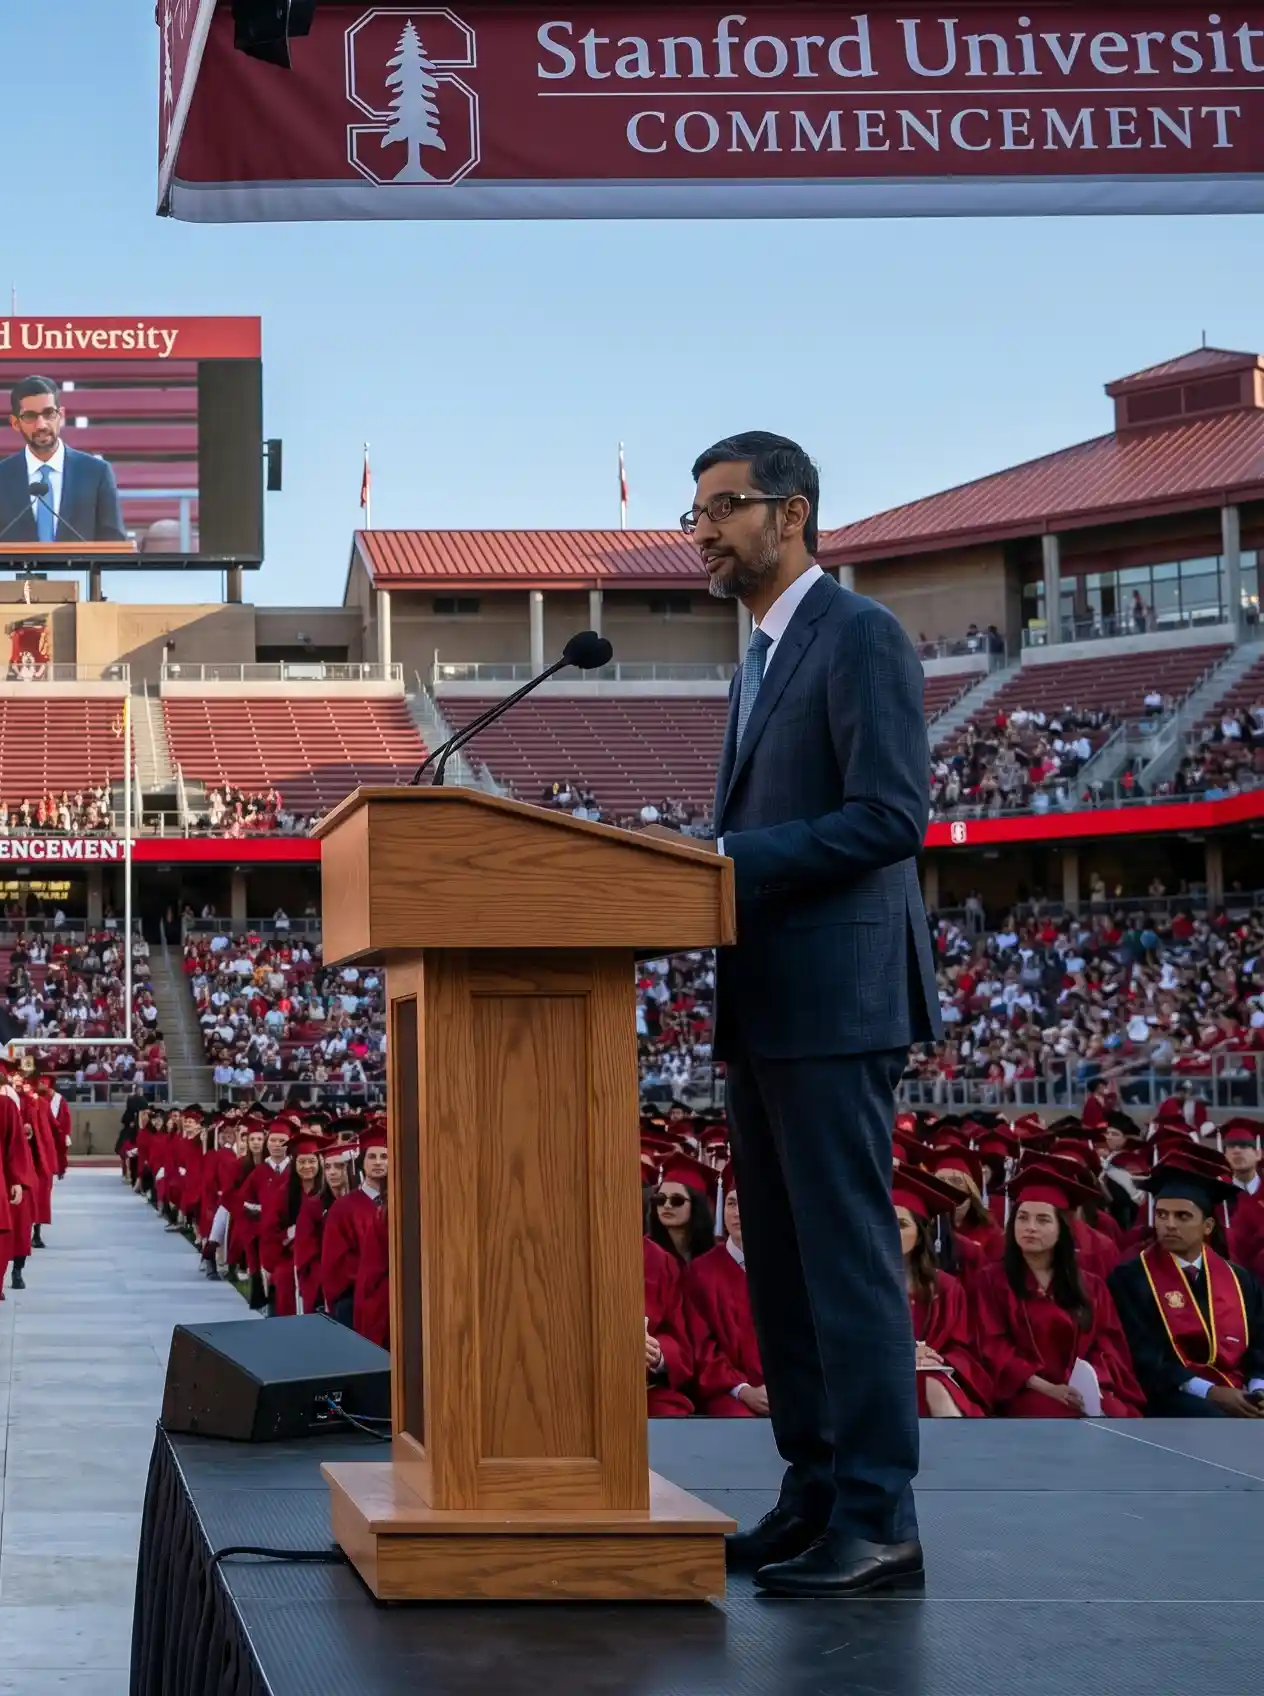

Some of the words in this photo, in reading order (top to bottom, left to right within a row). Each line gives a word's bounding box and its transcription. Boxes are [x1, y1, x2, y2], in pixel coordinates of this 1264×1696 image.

[537, 14, 878, 79] Stanford
[626, 106, 1240, 153] COMMENCEMENT
[20, 322, 178, 358] University
